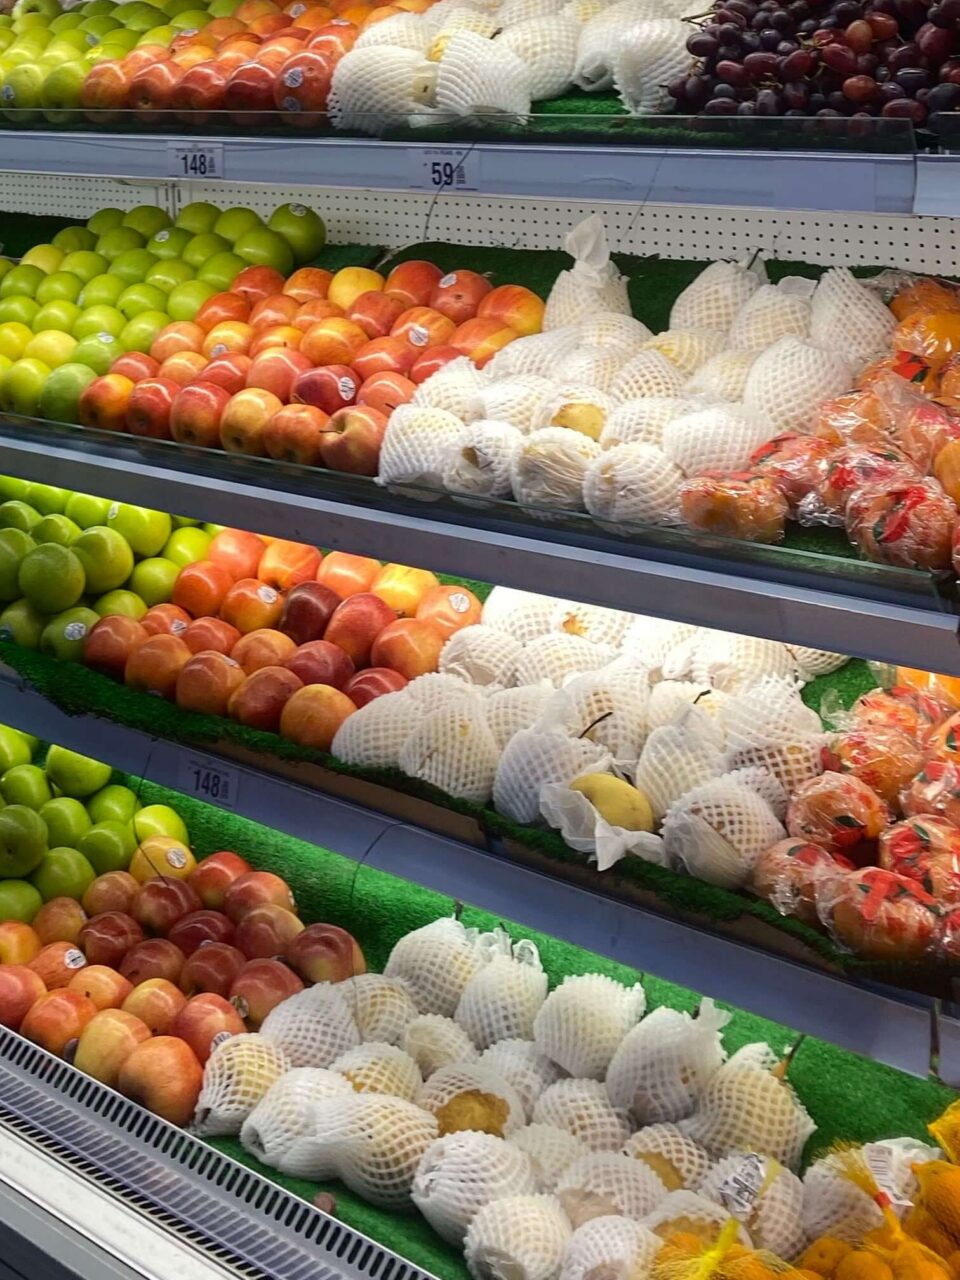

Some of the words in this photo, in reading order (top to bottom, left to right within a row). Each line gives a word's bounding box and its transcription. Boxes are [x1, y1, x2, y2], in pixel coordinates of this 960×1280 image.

[181, 154, 207, 174] 148
[432, 162, 453, 185] 59
[193, 769, 220, 798] 148
